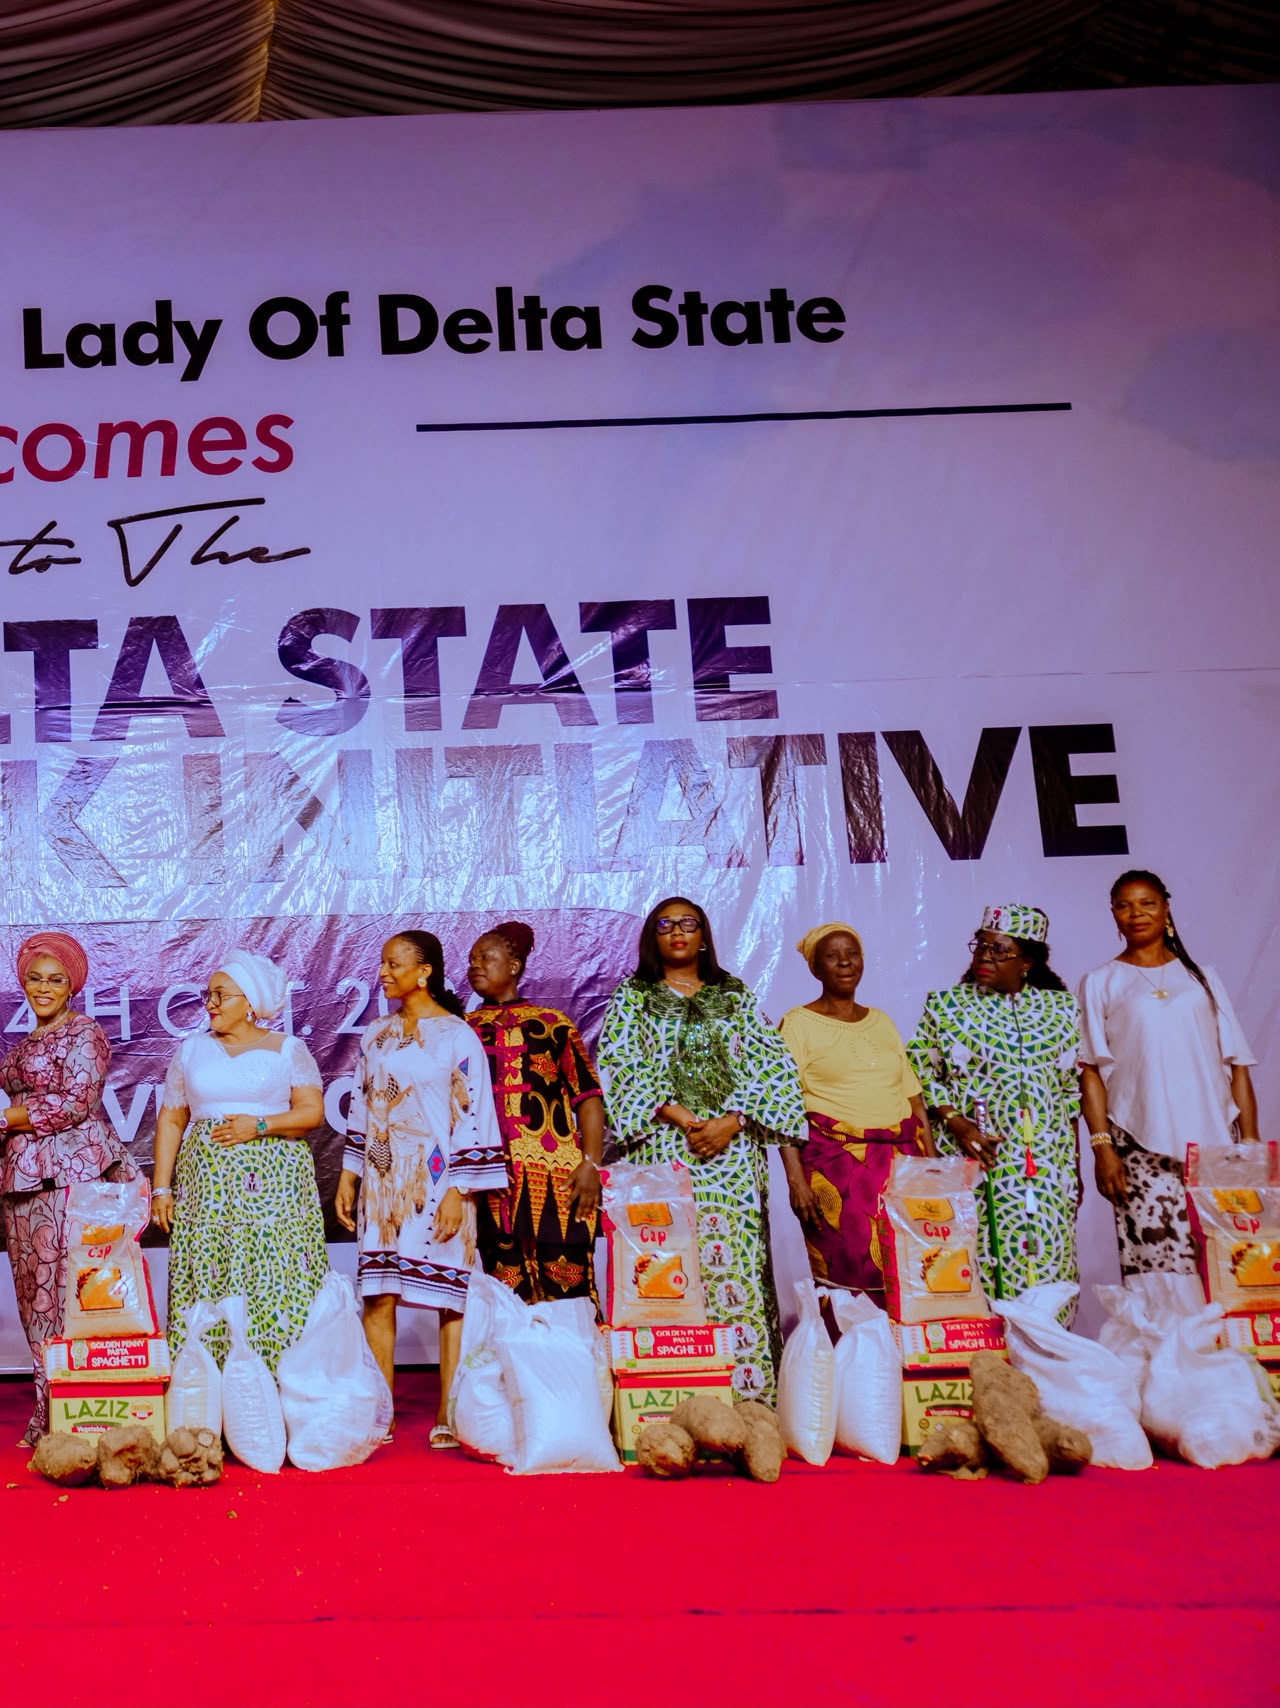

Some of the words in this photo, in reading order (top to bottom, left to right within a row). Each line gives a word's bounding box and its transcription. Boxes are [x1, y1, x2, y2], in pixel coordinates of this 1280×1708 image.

[23, 300, 223, 381] Lady
[248, 291, 351, 360] Of
[381, 287, 603, 356] Delta
[631, 285, 846, 349] State
[107, 498, 312, 587] The
[276, 595, 780, 738] STATE
[182, 722, 1130, 888] INITIATIVE
[640, 1226, 666, 1246] Cap
[923, 1222, 951, 1241] Cap
[88, 1245, 112, 1260] Cap
[90, 1341, 121, 1349] GOLDEN
[107, 1348, 129, 1356] PASTA
[657, 1344, 714, 1355] SPAGHETTI
[91, 1355, 146, 1367] SPAGHETTI
[63, 1400, 130, 1420] LAZIZ
